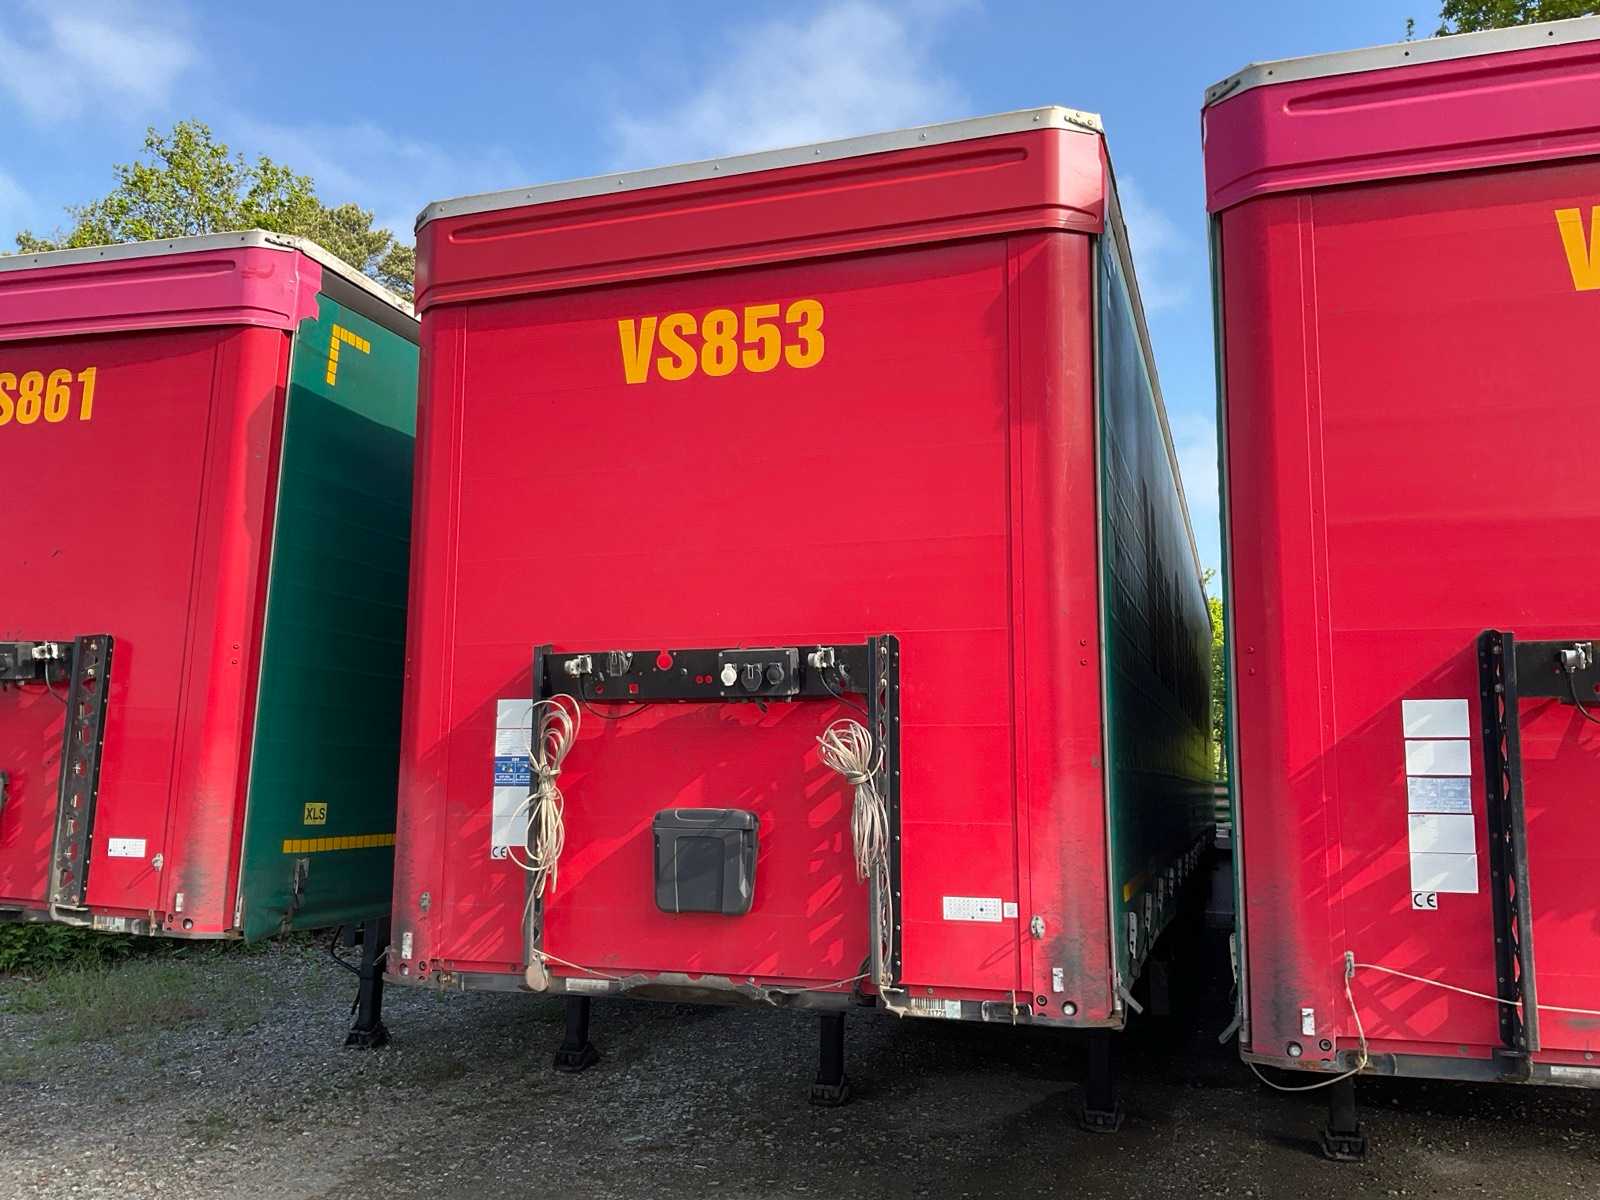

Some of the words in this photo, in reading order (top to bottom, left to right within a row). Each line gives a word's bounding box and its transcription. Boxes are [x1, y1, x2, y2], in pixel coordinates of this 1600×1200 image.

[619, 299, 824, 384] VS853
[0, 367, 96, 425] S861
[306, 807, 325, 820] XLS
[492, 846, 507, 858] CE
[1413, 893, 1437, 907] CE
